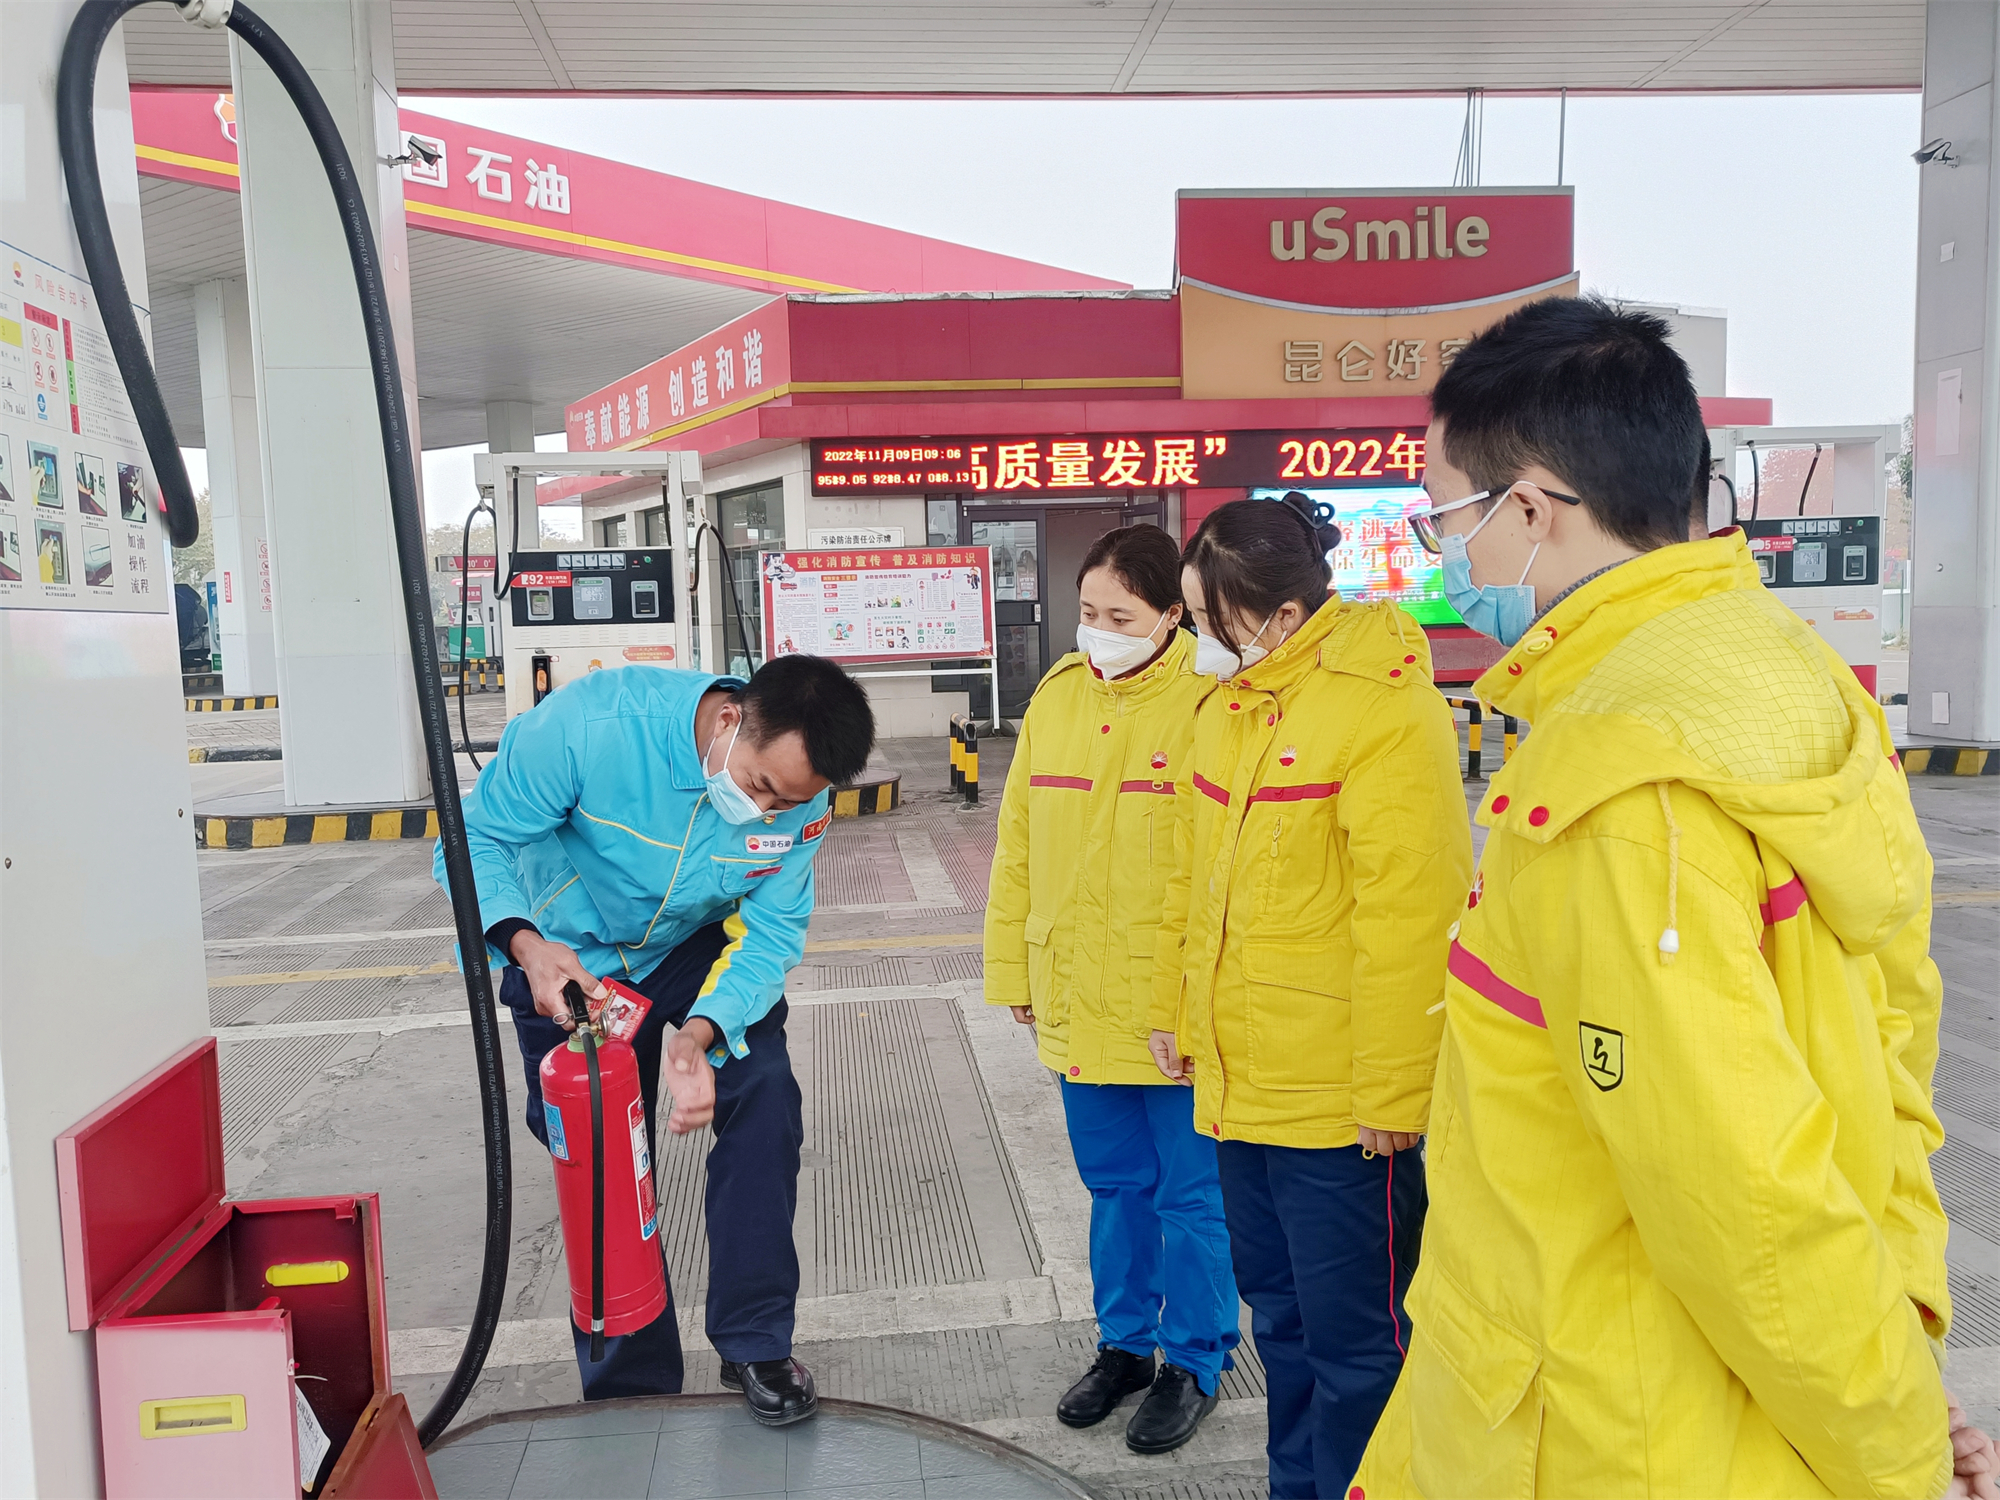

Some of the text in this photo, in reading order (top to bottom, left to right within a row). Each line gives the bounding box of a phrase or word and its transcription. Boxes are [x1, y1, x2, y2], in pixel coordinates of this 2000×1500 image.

[1270, 206, 1490, 261] uSmile
[35, 274, 88, 311] 风险告知卡
[585, 329, 763, 450] 奉献能源 创造和谐
[1279, 434, 1427, 481] 2022年
[127, 533, 146, 551] 加油
[820, 534, 892, 545] 污染防治责任公示牌
[129, 556, 148, 572] 操作
[797, 552, 977, 569] 强化消防宣传 普及消防知识
[131, 578, 150, 594] 流程
[799, 576, 817, 588] 消防
[762, 840, 792, 848] 中国石油
